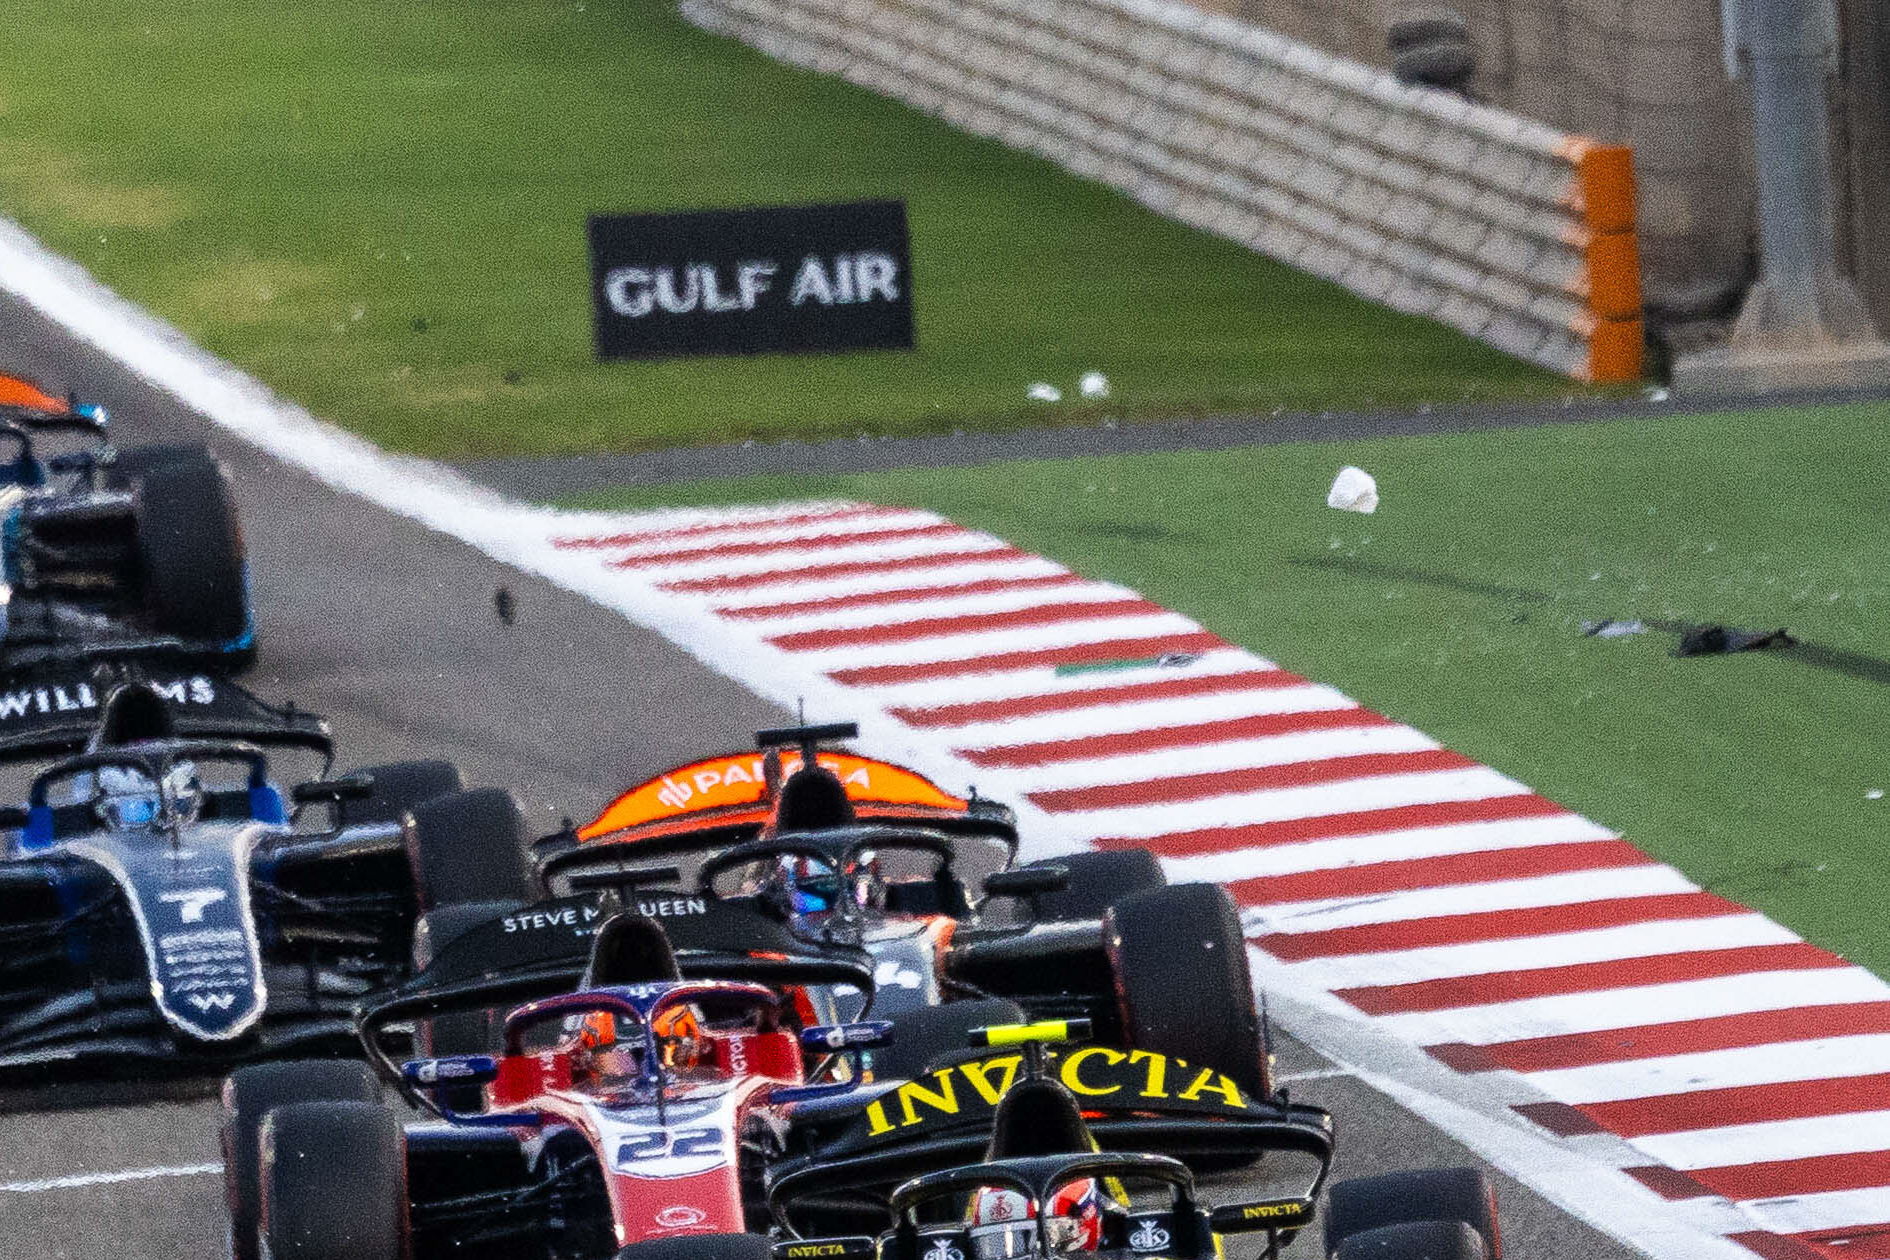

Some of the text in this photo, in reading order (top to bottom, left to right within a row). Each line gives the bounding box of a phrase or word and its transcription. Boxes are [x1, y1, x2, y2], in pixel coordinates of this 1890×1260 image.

[605, 249, 900, 318] GULF AIR
[160, 887, 228, 924] 7
[503, 898, 707, 932] STEVE MUEEN
[866, 1047, 1248, 1137] INVCTA
[617, 1127, 723, 1165] 22
[1243, 1202, 1302, 1219] INVICTA
[787, 1243, 845, 1258] INVICTA
